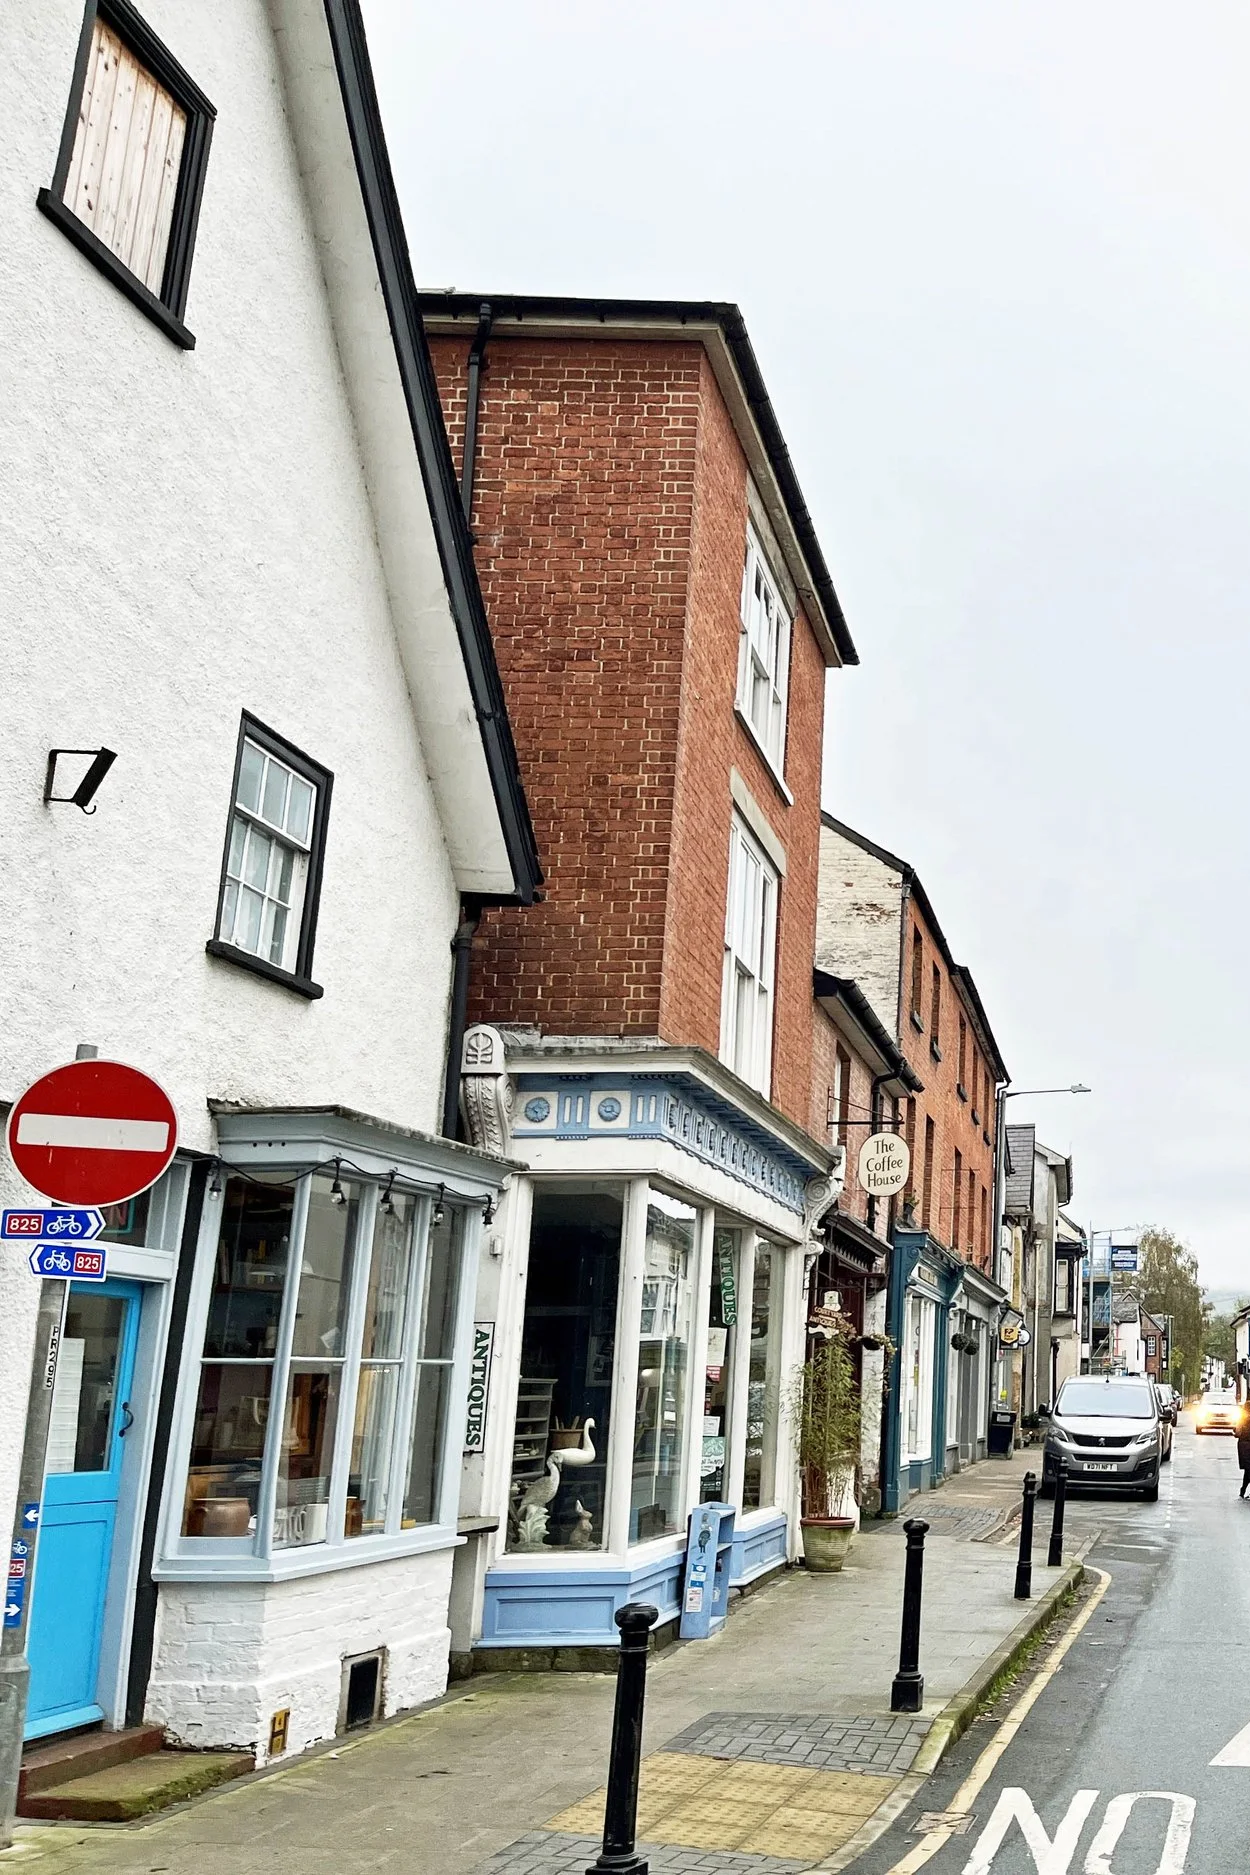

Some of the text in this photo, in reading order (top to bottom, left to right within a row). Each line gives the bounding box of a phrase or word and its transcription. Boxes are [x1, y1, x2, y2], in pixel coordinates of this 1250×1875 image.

[873, 1138, 895, 1155] The
[866, 1155, 904, 1173] Coffee
[867, 1172, 902, 1188] House
[9, 1217, 39, 1231] 825
[76, 1256, 99, 1270] 825
[719, 1229, 737, 1326] ANTIQUES
[46, 1326, 60, 1388] PR295
[465, 1328, 490, 1446] ANTIQUES
[9, 1563, 24, 1574] 25
[961, 1788, 1197, 1875] NO
